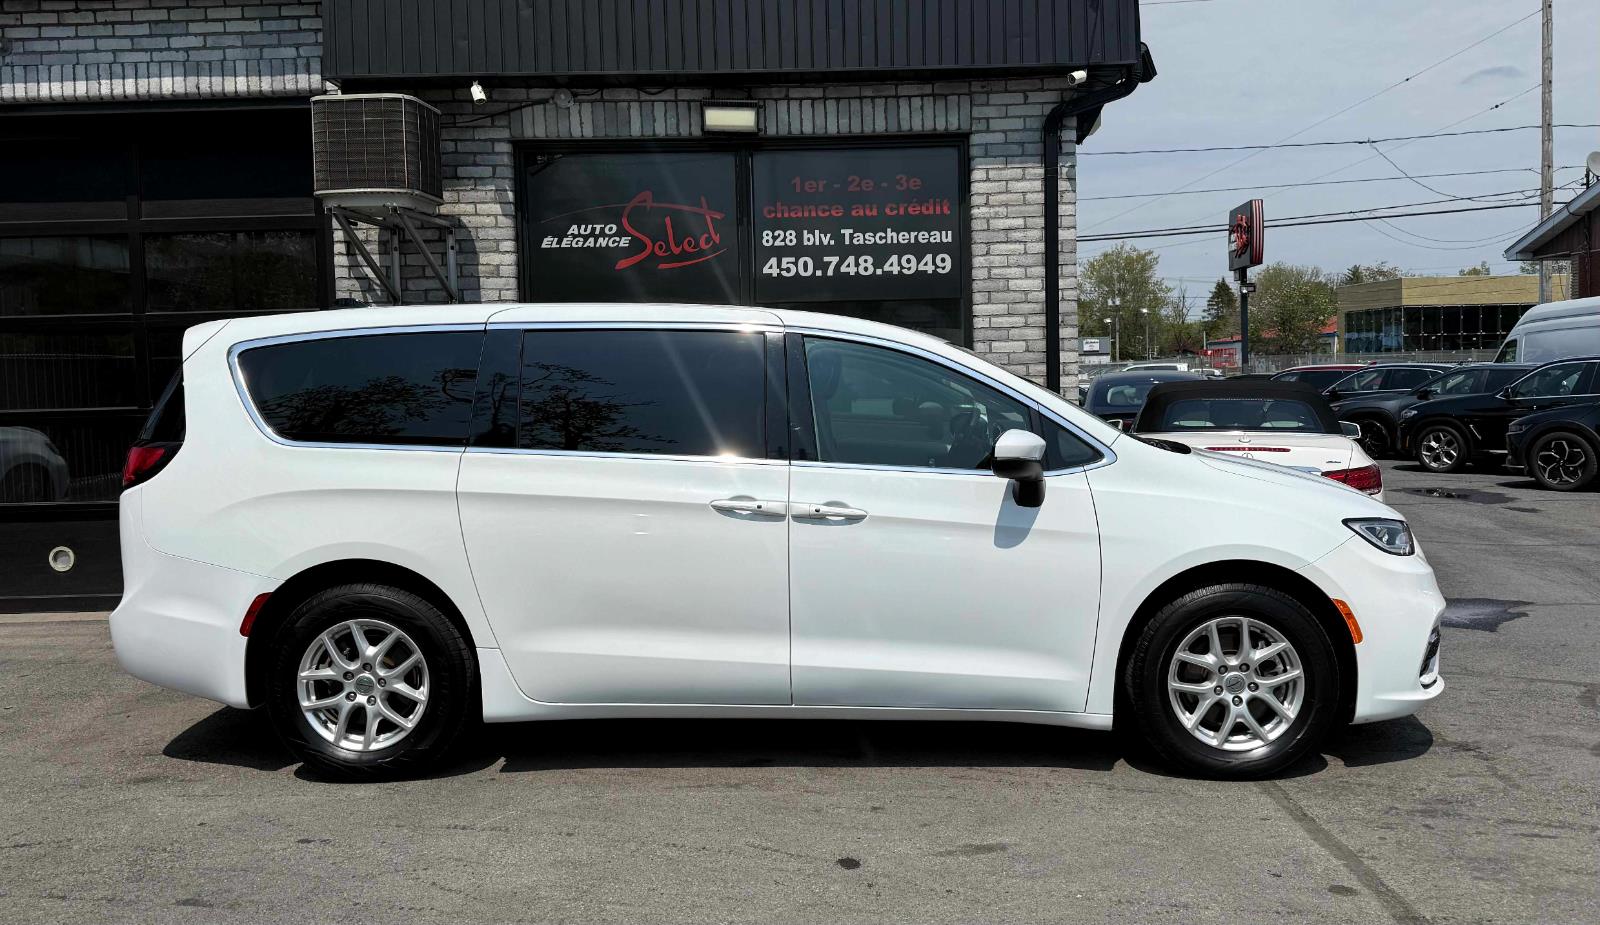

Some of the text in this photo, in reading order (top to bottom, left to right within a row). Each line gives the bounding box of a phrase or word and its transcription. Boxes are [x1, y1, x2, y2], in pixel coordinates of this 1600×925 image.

[791, 176, 827, 193] 1er
[848, 175, 874, 192] 2e
[896, 174, 922, 190] 3e
[763, 198, 951, 219] chance au crédit
[567, 223, 617, 235] AUTO
[615, 190, 725, 270] Select
[762, 228, 952, 247] 828 blv. Taschereau
[540, 235, 631, 248] ÉLÉGANCE
[762, 253, 952, 277] 450.748.4949
